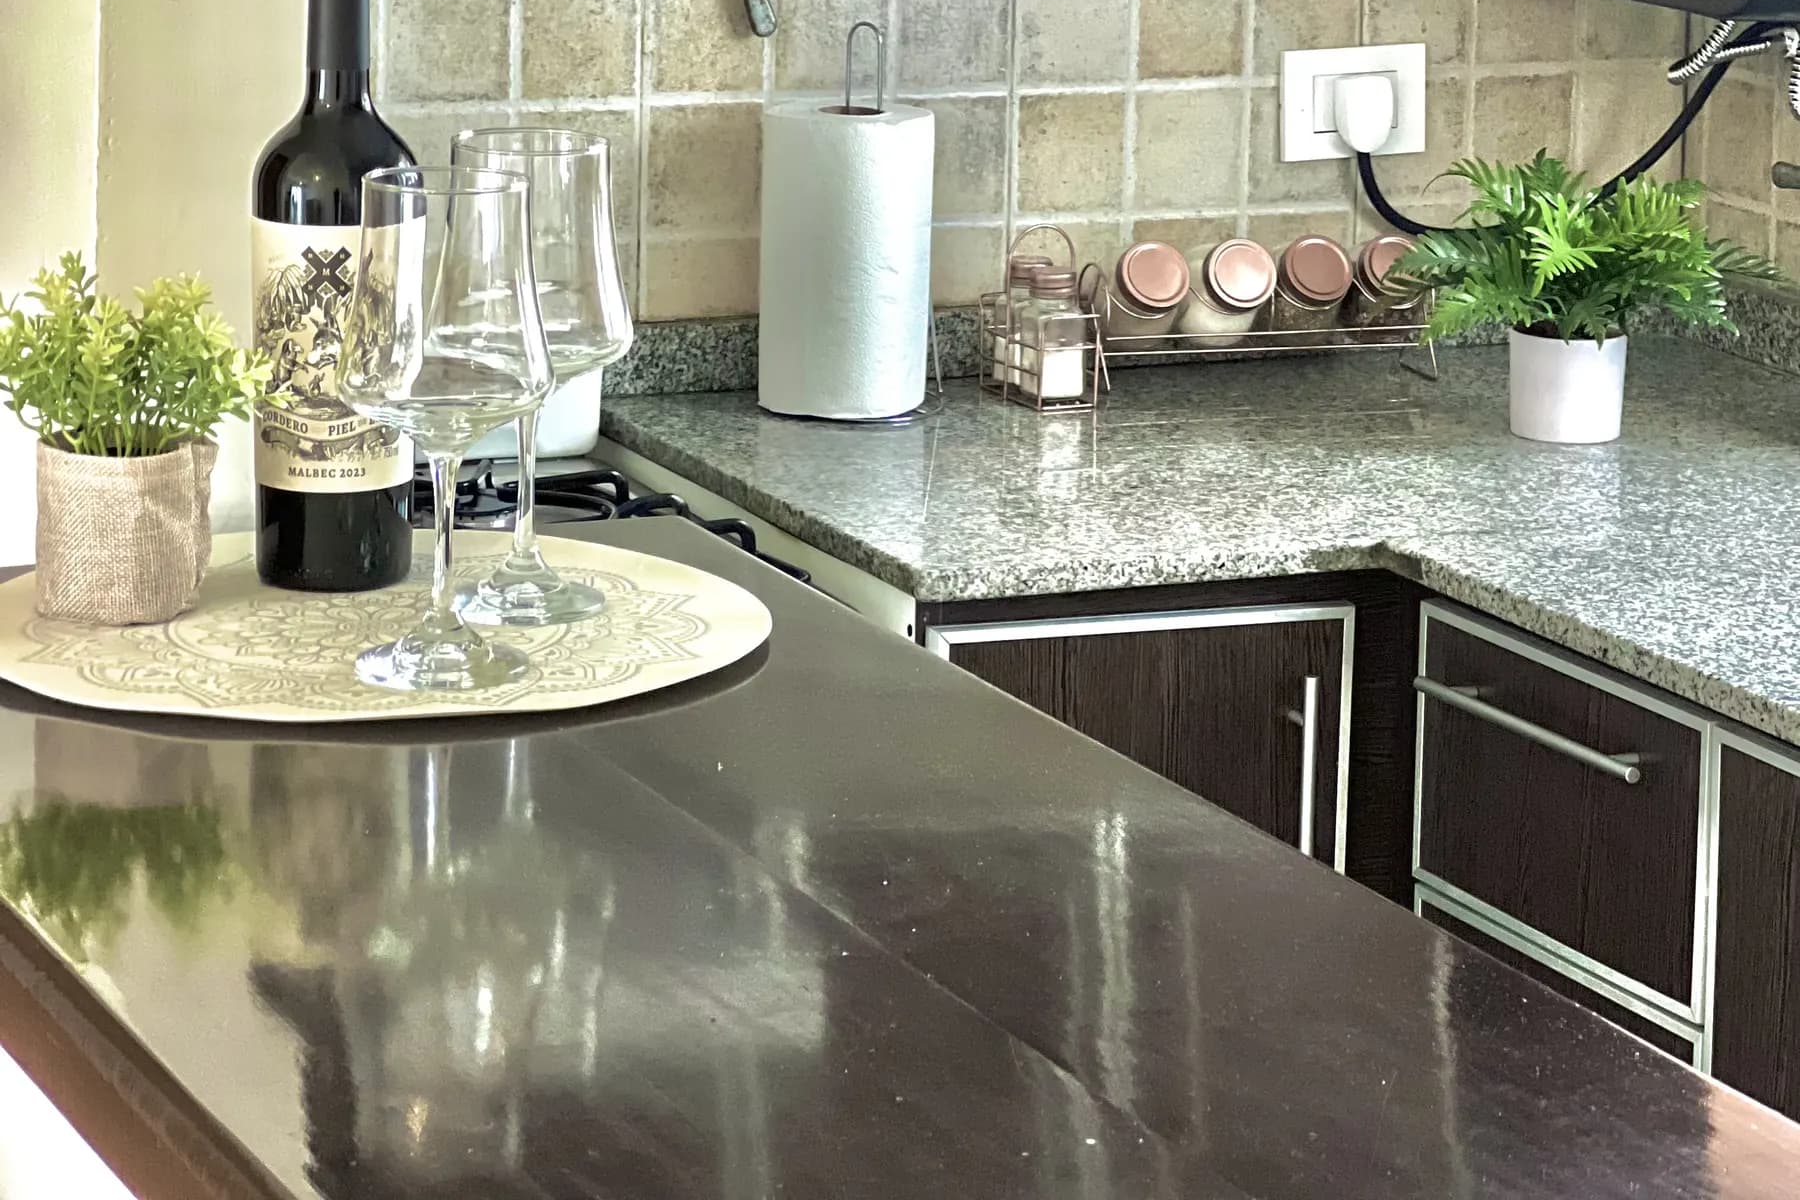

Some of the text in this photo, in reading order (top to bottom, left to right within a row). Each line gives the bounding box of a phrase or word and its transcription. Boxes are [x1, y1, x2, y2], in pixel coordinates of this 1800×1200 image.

[263, 409, 309, 434] CORDERO
[328, 420, 356, 437] PIEL
[288, 467, 366, 478] MALBEC 2023
